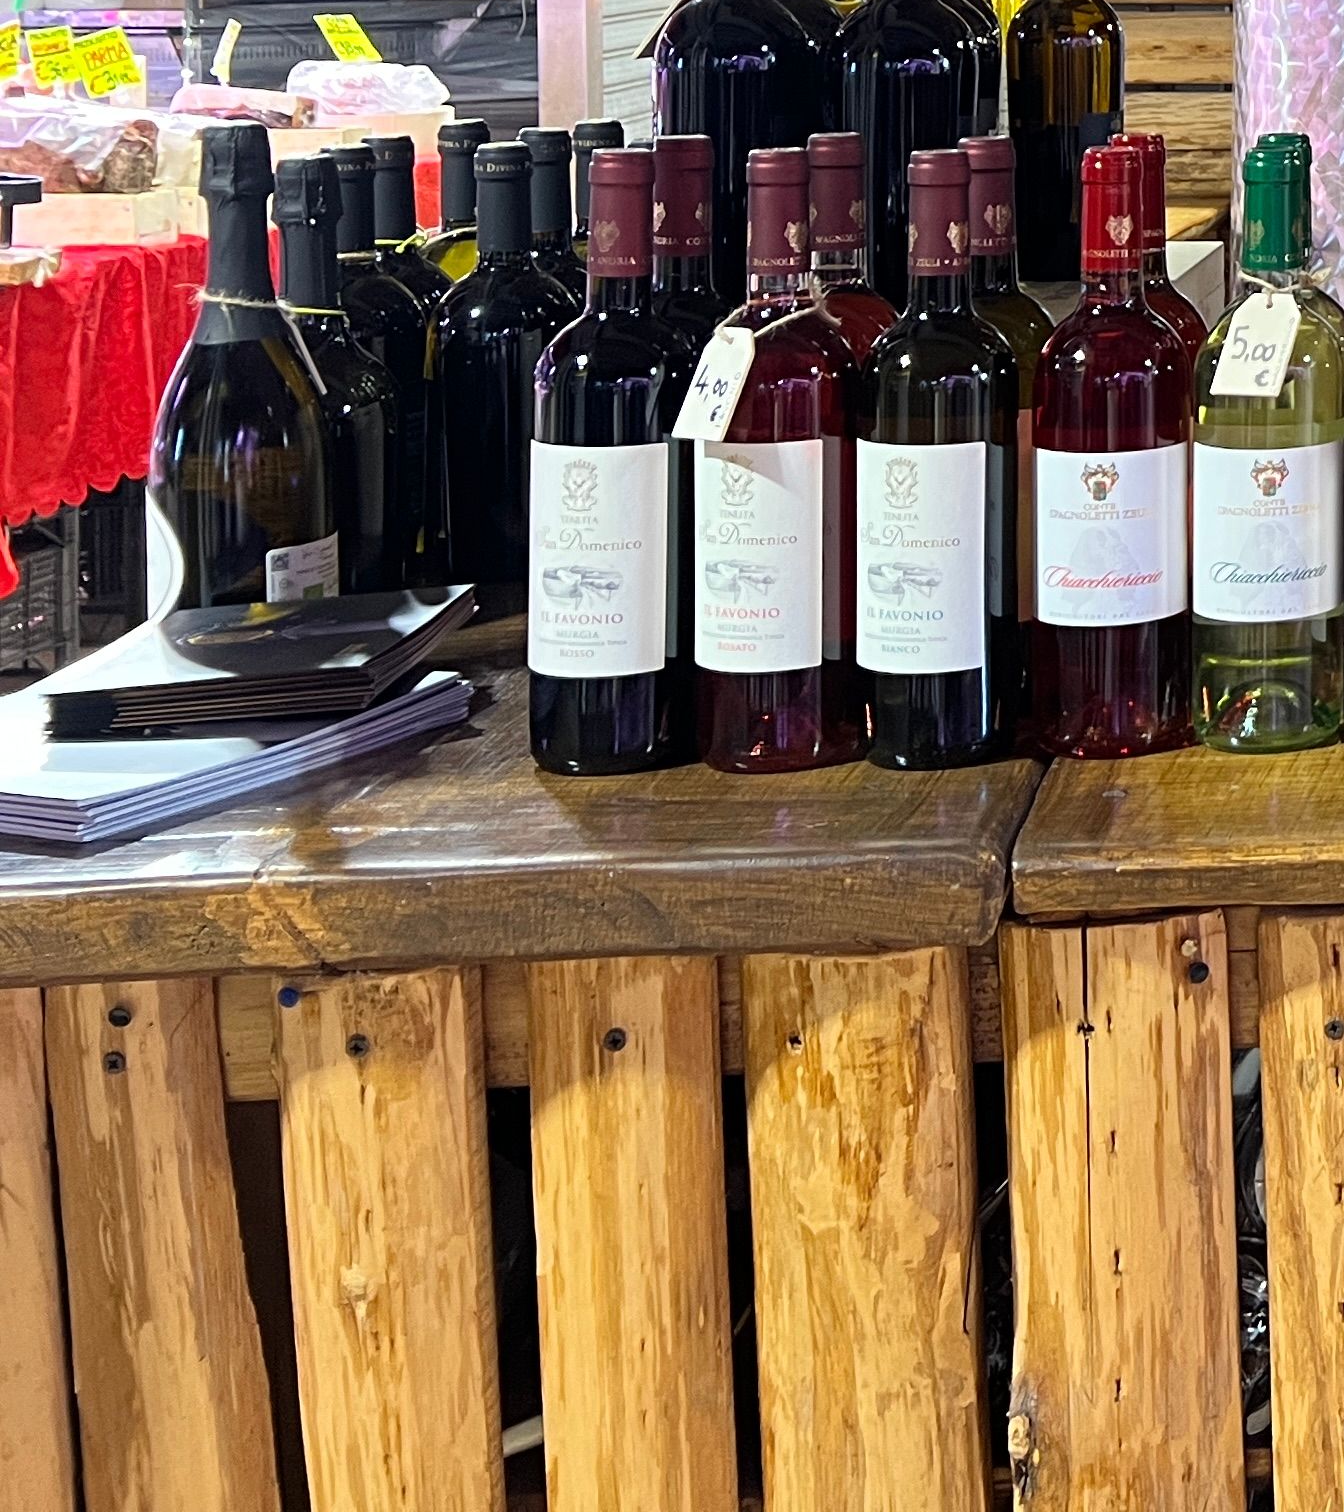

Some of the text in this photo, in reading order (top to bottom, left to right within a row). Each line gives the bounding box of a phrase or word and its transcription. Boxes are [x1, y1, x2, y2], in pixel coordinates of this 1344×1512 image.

[1231, 326, 1276, 364] 5,00
[1254, 370, 1269, 387] €
[558, 526, 642, 551] Domenico
[719, 523, 798, 545] Domenico
[882, 525, 960, 548] Domenico
[1043, 566, 1162, 589] Chiacchiericcio
[1209, 561, 1327, 585] Chiacchiericcio
[554, 612, 624, 626] FAVONIO
[716, 606, 781, 619] FAVONIO
[878, 608, 944, 621] FAVONIO
[559, 649, 595, 658] ROSSO
